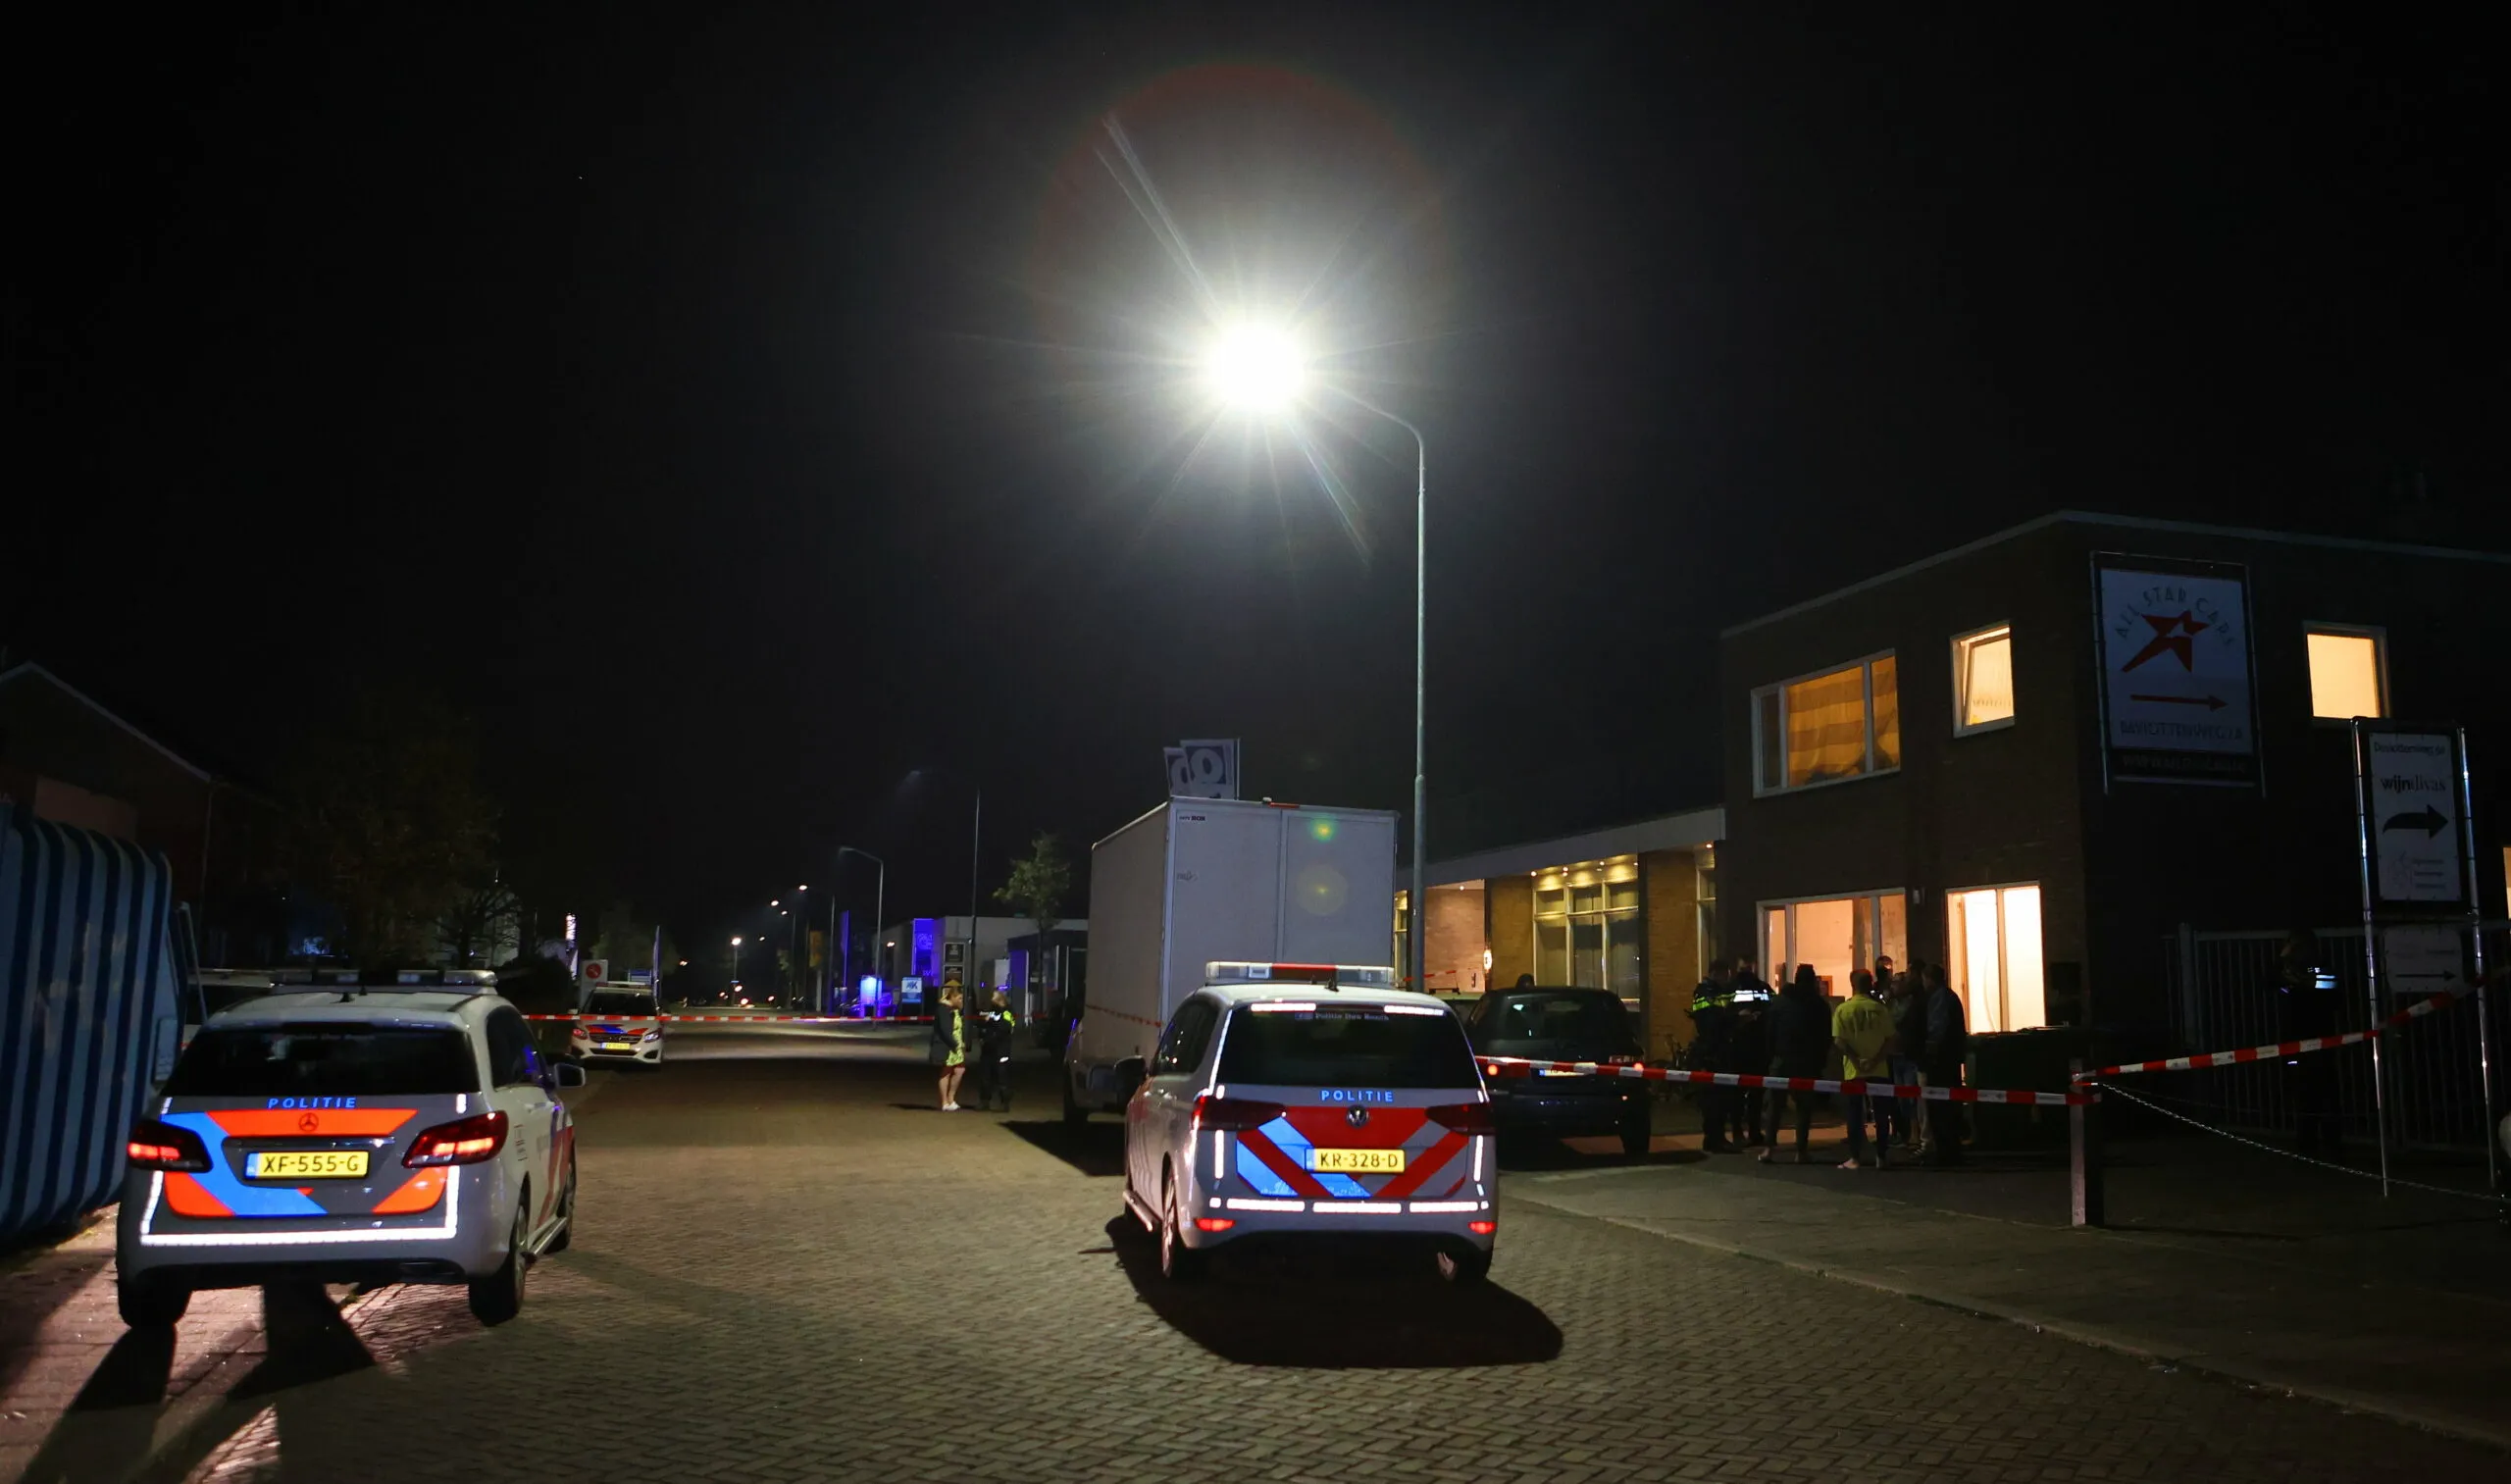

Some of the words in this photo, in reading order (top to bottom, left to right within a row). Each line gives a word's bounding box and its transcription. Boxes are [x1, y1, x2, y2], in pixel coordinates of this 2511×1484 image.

[2115, 603, 2140, 639] ALL
[2142, 587, 2186, 607] STAR
[268, 1097, 356, 1109] POLITIE
[1320, 1090, 1393, 1102] POLITIE
[264, 1155, 359, 1172] XF-555-G
[1320, 1152, 1398, 1168] KR-328-D
